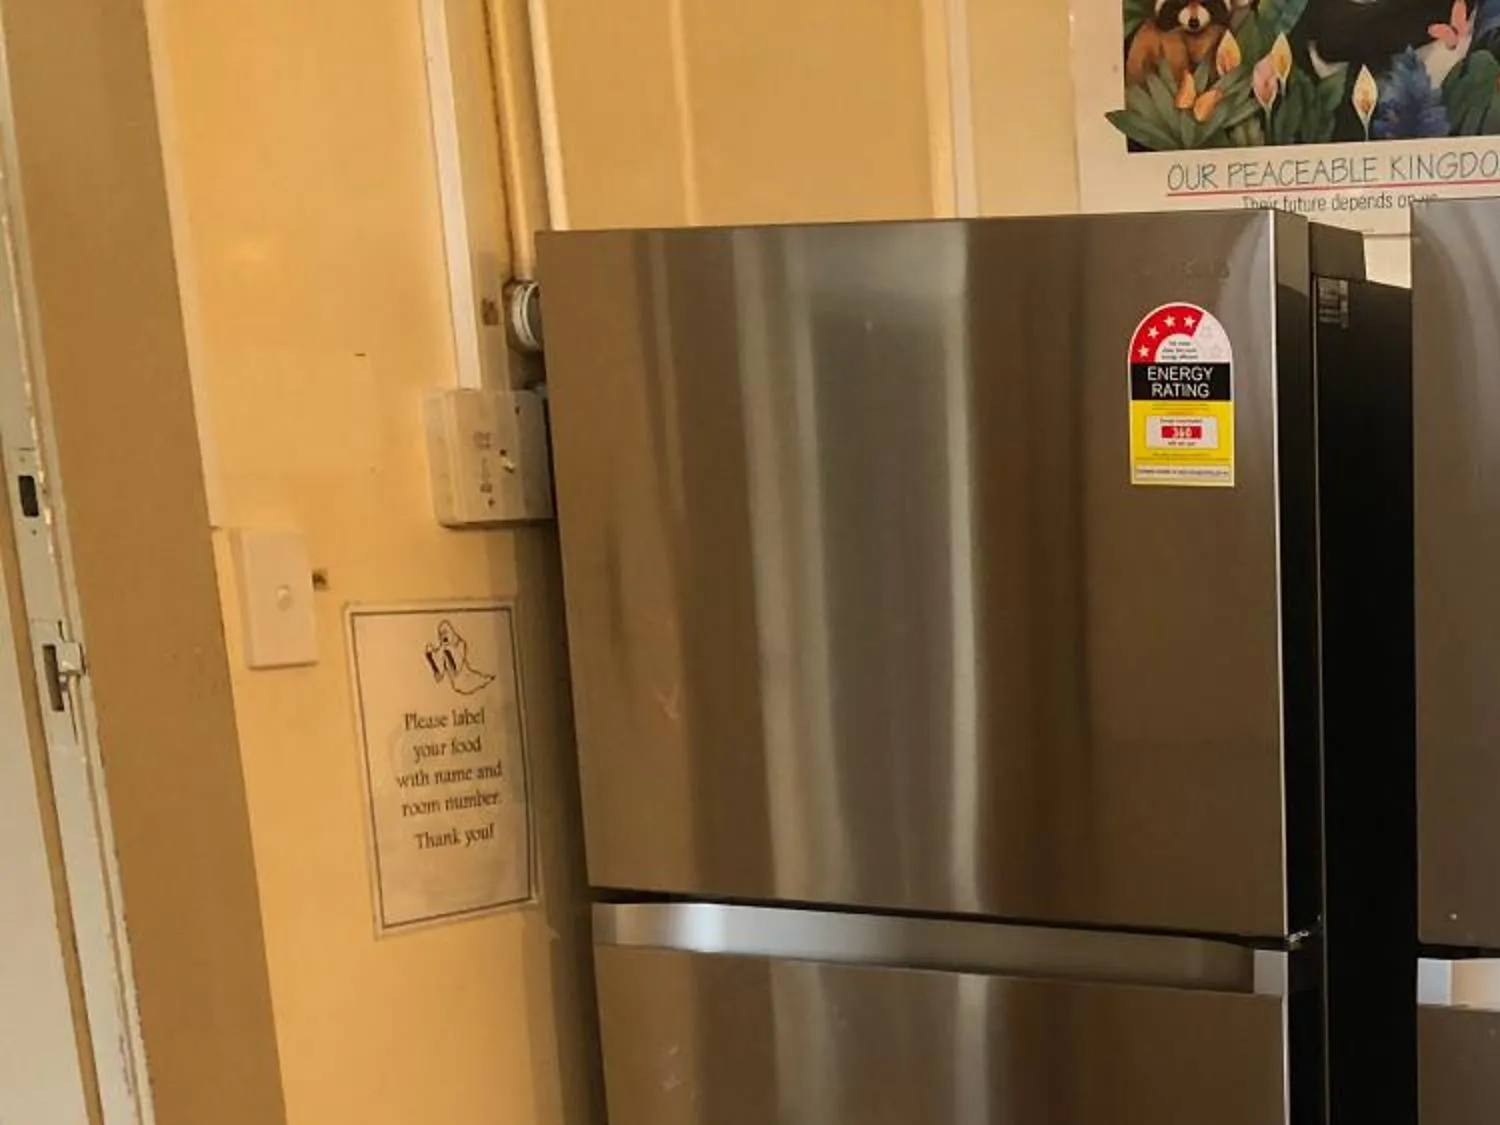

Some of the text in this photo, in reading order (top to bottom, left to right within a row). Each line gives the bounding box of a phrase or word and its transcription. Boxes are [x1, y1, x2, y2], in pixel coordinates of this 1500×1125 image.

[1167, 163, 1219, 191] OUR
[1227, 157, 1378, 187] PEACEABLE
[1283, 196, 1327, 214] future
[1331, 192, 1393, 212] depends
[1147, 366, 1214, 381] ENERGY
[1151, 383, 1210, 398] RATING
[402, 707, 486, 731] Please label
[412, 735, 482, 765] your food
[396, 758, 503, 788] with name and
[401, 800, 441, 817] room
[414, 822, 495, 849] Thank you!
